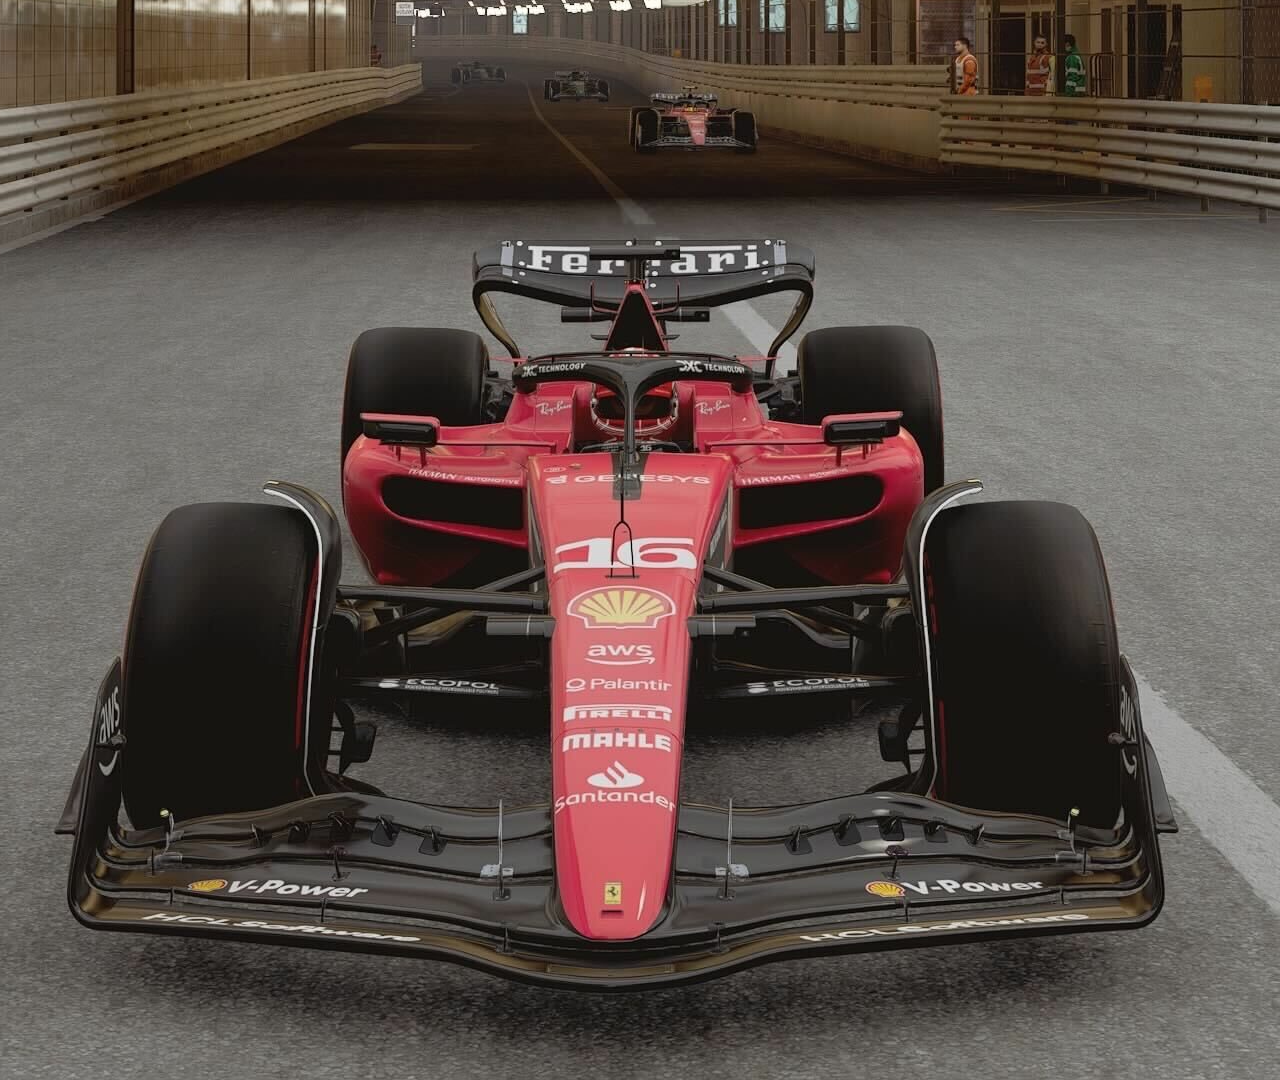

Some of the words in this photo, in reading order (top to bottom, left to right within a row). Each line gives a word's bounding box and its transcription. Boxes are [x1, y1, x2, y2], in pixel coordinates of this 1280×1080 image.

[539, 362, 586, 373] TECHNOLOGY
[408, 468, 457, 480] HARMAN
[464, 476, 520, 485] AUTOMOTIVE
[741, 474, 800, 485] HARMAN
[553, 538, 697, 573] 16
[587, 644, 653, 657] aws
[406, 678, 499, 690] ECOPOL
[591, 678, 672, 692] Palantir
[773, 677, 868, 688] ECOPOL
[563, 703, 672, 722] PIRELLI
[562, 733, 671, 753] MAHLE
[554, 789, 676, 814] Santander
[227, 879, 369, 898] V-Power
[903, 879, 1045, 895] V-Power
